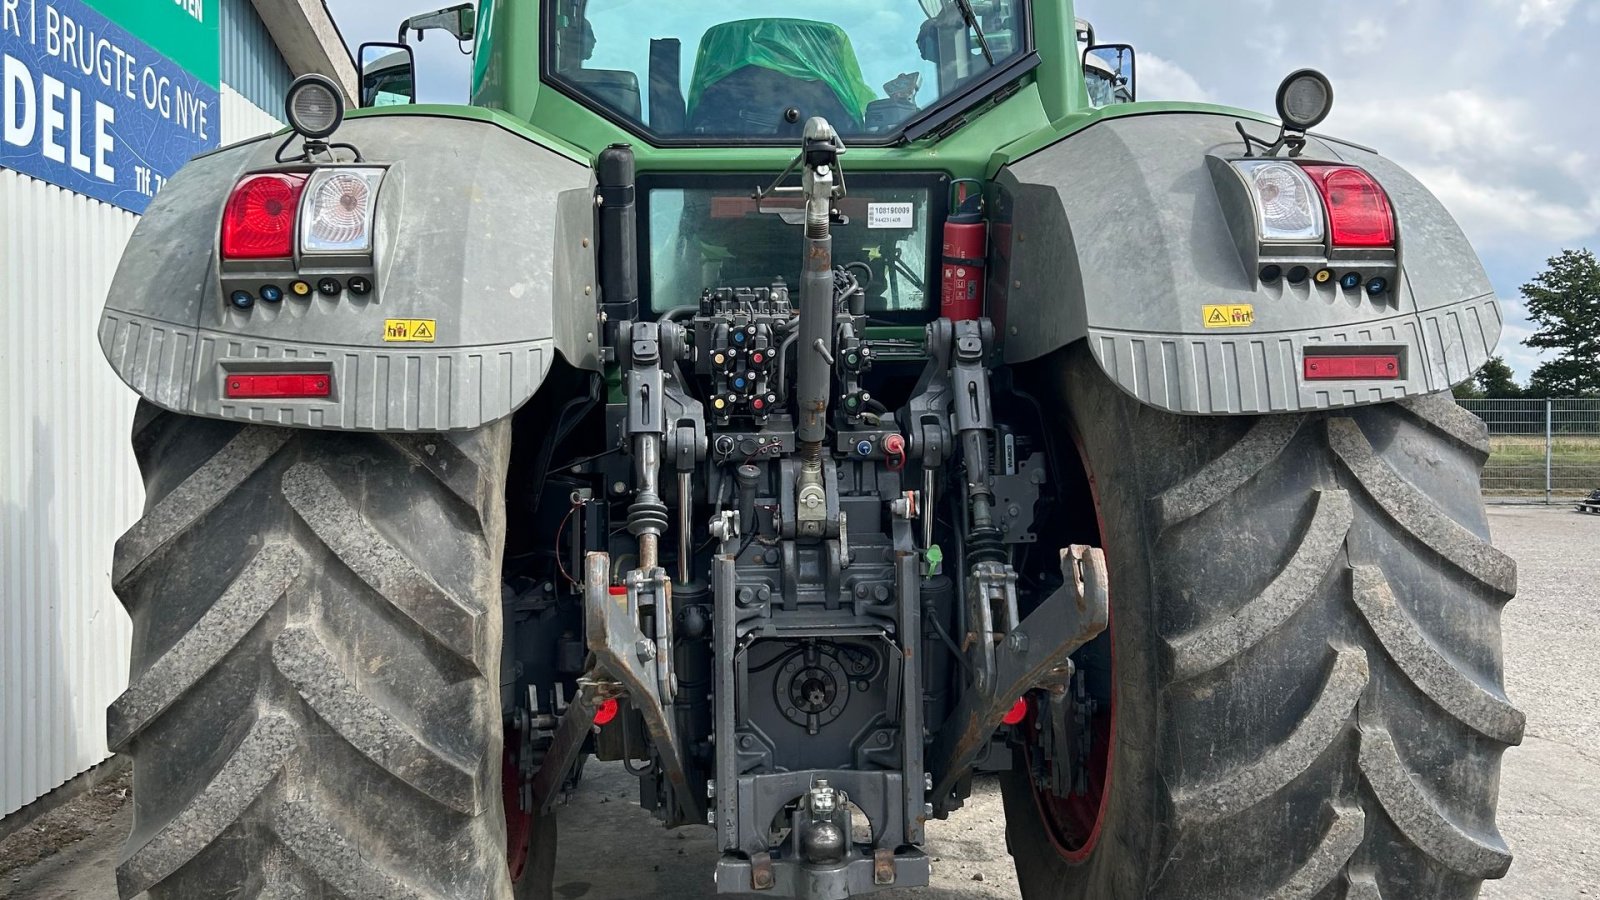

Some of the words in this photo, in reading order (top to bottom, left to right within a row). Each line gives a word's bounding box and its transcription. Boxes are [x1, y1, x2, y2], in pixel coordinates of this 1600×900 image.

[4, 53, 115, 183] DELE
[46, 4, 136, 100] BRUGTE
[142, 66, 170, 119] OG
[176, 85, 208, 141] NYE
